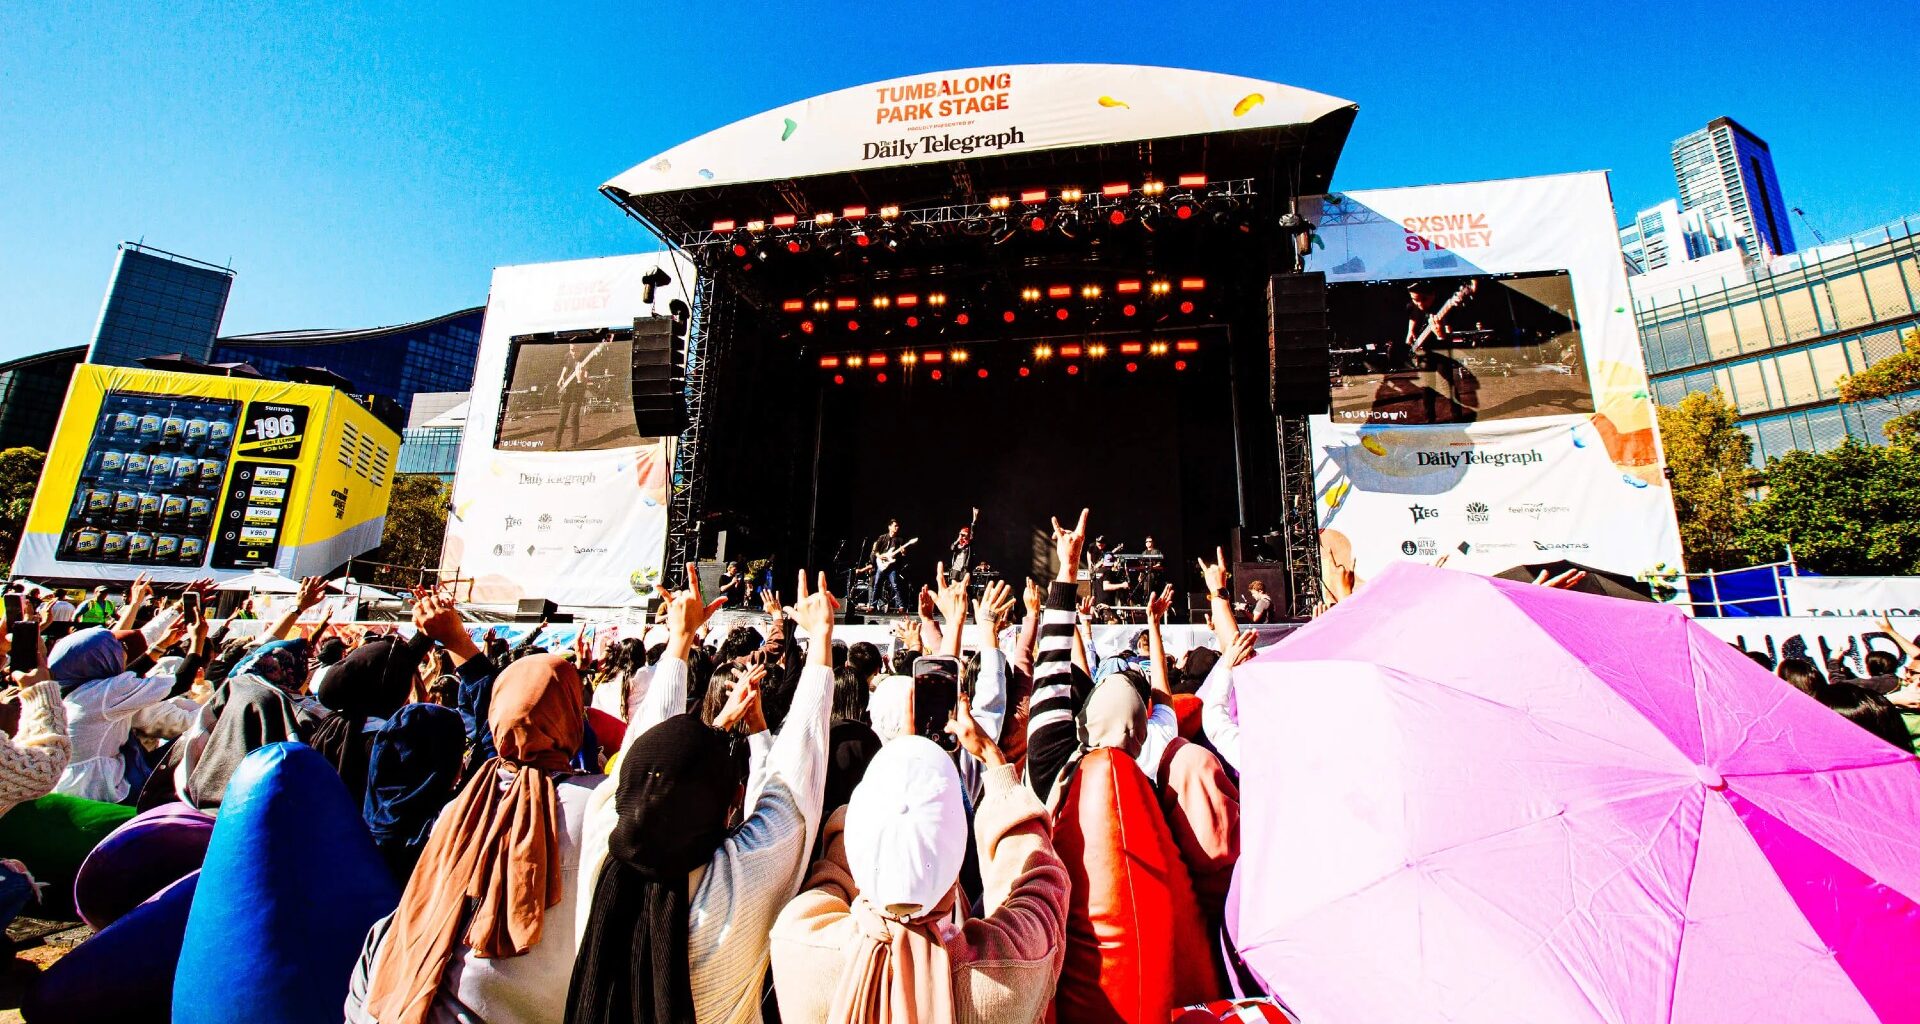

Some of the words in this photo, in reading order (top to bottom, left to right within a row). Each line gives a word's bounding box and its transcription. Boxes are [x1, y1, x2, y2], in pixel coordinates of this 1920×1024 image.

[876, 73, 1011, 104] TUMBALONG
[876, 102, 934, 124] PARK
[939, 93, 1009, 117] STAGE
[862, 138, 918, 160] Daily
[920, 126, 1025, 153] Telegraph
[1403, 214, 1464, 233] SXSW
[1405, 230, 1492, 252] SYDNEY
[246, 415, 295, 440] -196
[1417, 451, 1460, 468] Daily
[1461, 449, 1543, 466] Telegraph
[1467, 514, 1489, 522] NSW
